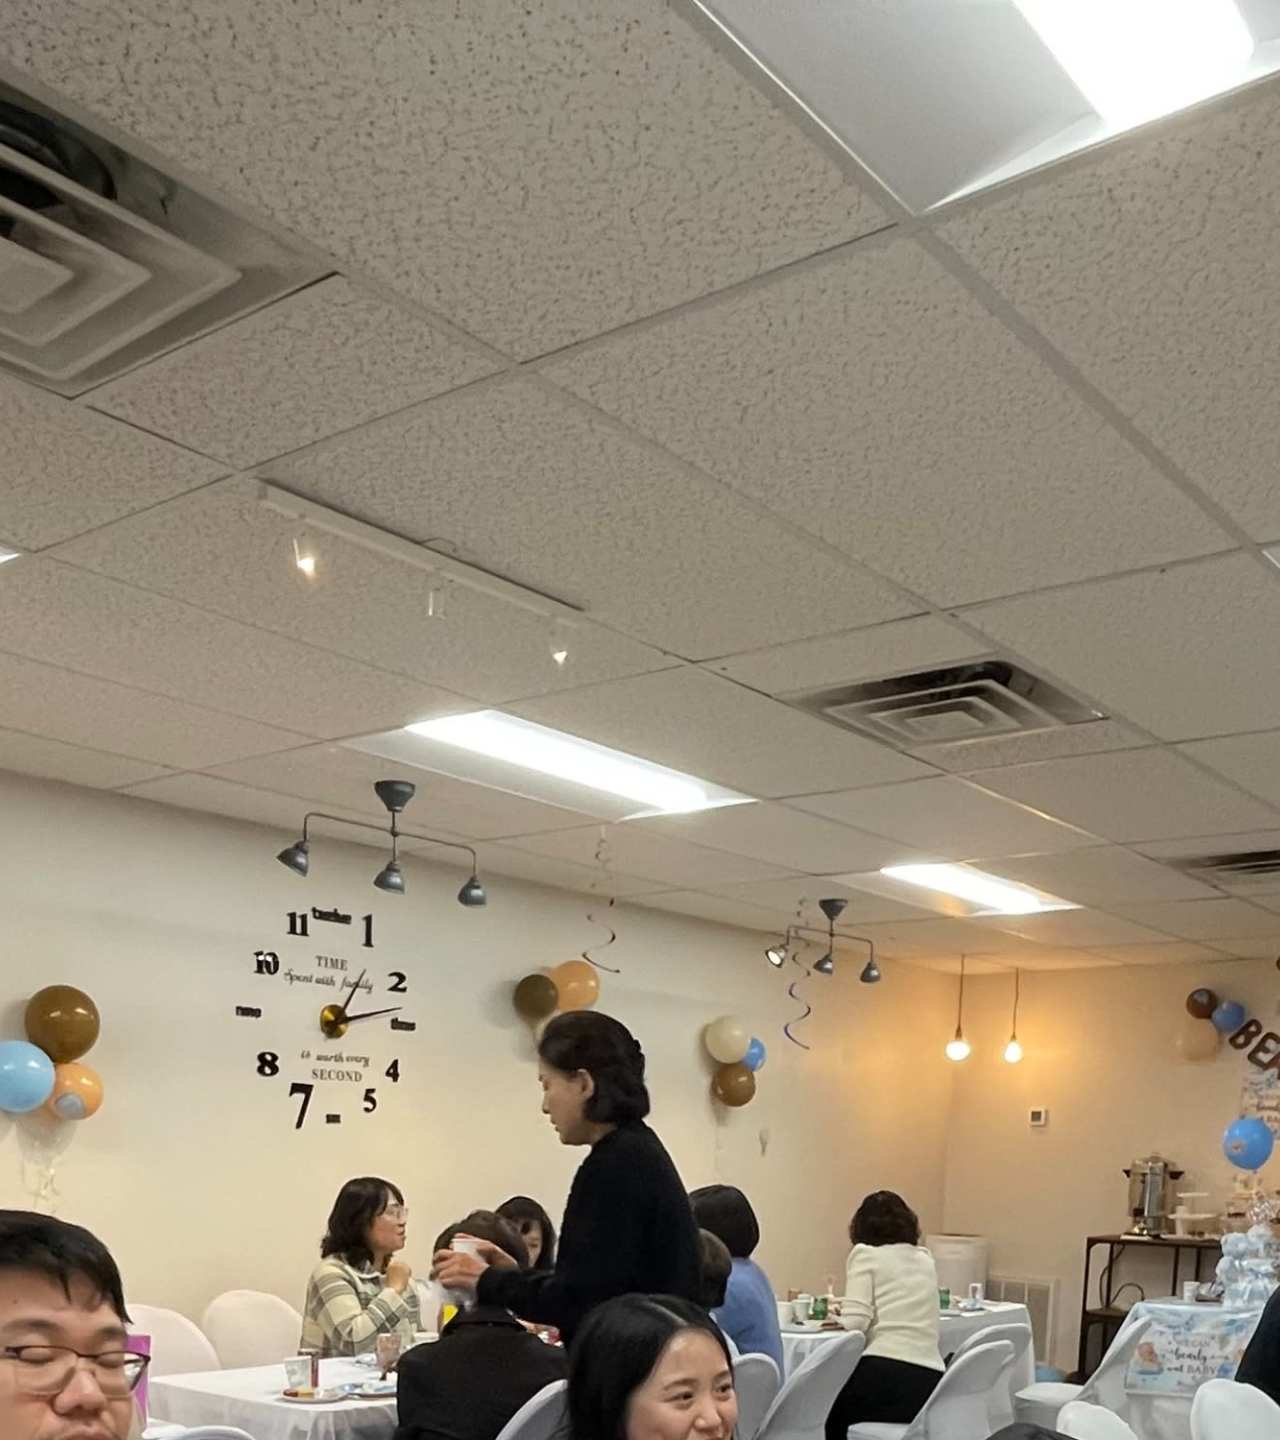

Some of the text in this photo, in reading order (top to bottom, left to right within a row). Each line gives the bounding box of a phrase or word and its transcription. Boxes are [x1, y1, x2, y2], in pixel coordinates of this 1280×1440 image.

[286, 911, 310, 937] 11
[362, 913, 375, 948] 1
[316, 955, 348, 971] TIME
[387, 971, 408, 993] 2
[256, 1051, 280, 1077] 8
[311, 1069, 363, 1082] SECOND
[385, 1058, 400, 1083] 4
[288, 1082, 314, 1130] 7
[363, 1087, 377, 1113] 5
